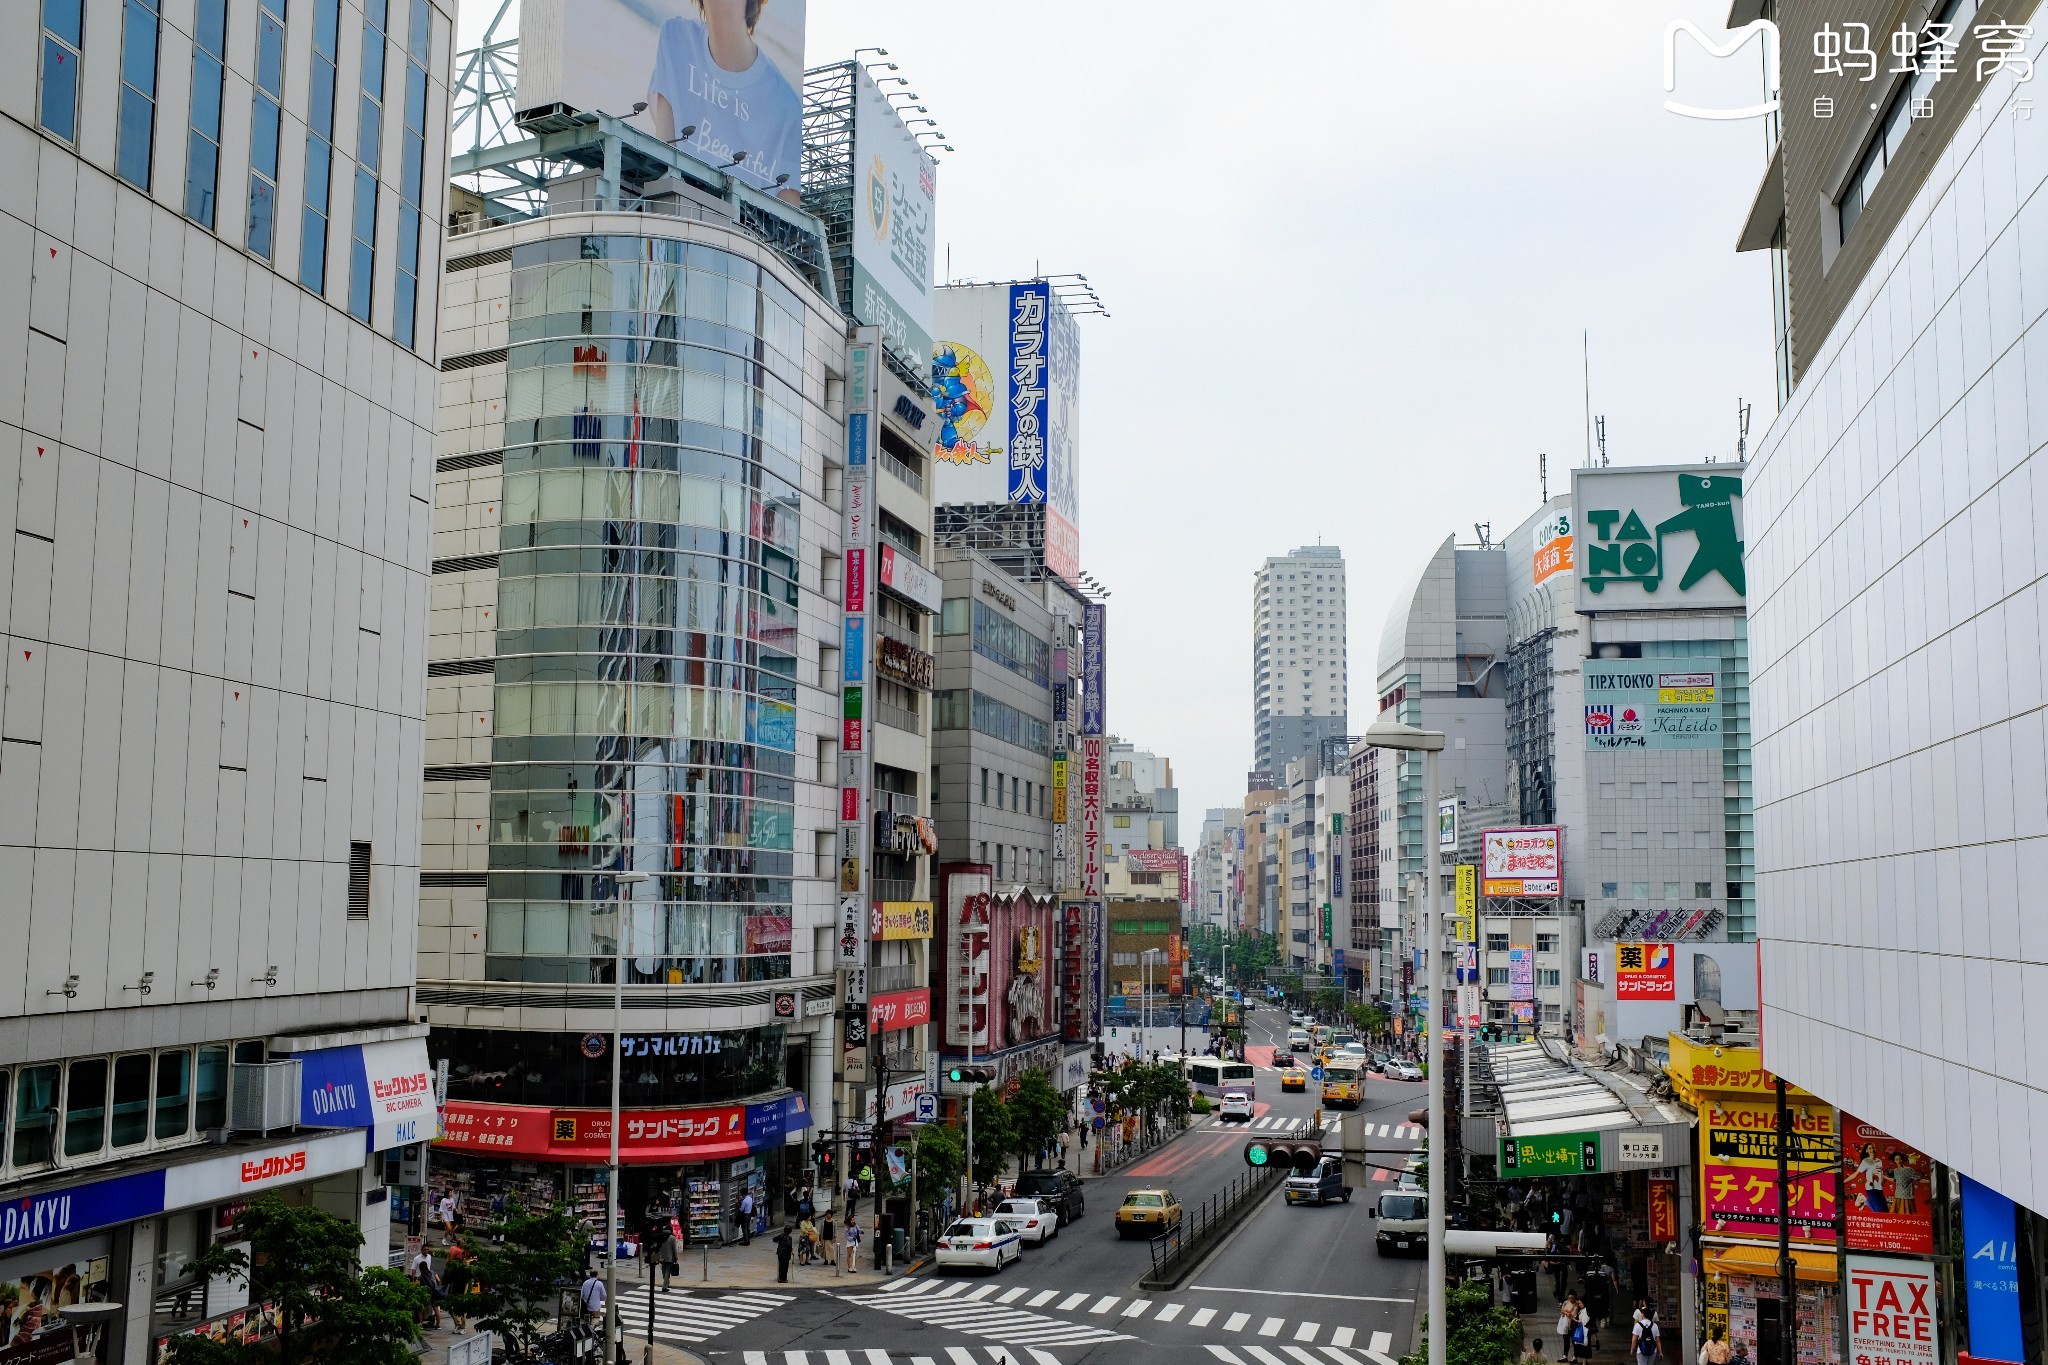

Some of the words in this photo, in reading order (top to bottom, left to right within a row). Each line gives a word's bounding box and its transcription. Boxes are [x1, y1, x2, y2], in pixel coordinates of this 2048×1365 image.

[688, 63, 728, 110] Life
[734, 90, 750, 121] is
[892, 171, 928, 235] シェーン
[892, 208, 926, 282] 英会話
[865, 283, 906, 347] 新宿本校
[1011, 290, 1044, 501] カラオケの鉄人
[1696, 501, 1730, 509] TANO-kun
[1085, 606, 1101, 733] カラオケの鉄人
[1618, 674, 1654, 688] TOKYO
[850, 720, 860, 749] 美容室
[1651, 715, 1717, 733] Kaleido
[1084, 739, 1100, 897] 100名収容大パーティールーム
[1515, 838, 1547, 850] カラオケ
[1507, 853, 1555, 872] まねきねこ
[1465, 869, 1473, 896] Money
[1497, 886, 1521, 894] ワンカラ
[872, 907, 882, 934] 3F
[1625, 908, 1655, 940] バーミヤン
[1656, 907, 1688, 940] ワンカラ
[843, 922, 857, 957] 黒太鼓
[958, 891, 990, 1034] パチンコ
[1620, 946, 1642, 969] 薬
[1618, 980, 1673, 992] サンドラッグ
[872, 1002, 896, 1023] カラオケ
[621, 1035, 721, 1057] サンマルクカフェ
[373, 1073, 428, 1099] ビックカメラ
[1692, 1064, 1763, 1088] 金券ショップ
[313, 1083, 356, 1115] ODAKYU
[386, 1102, 397, 1113] BIC
[398, 1098, 423, 1111] CAMERA
[396, 1121, 416, 1143] HALC
[555, 1118, 576, 1140] 薬
[628, 1116, 720, 1139] サンドラッグ
[1507, 1142, 1514, 1164] 新宿
[1521, 1145, 1578, 1166] 思い出横丁
[1585, 1145, 1595, 1167] 西口
[1623, 1144, 1659, 1152] 東口近道
[241, 1151, 306, 1183] ビックカメラ
[1710, 1174, 1836, 1210] チケット
[0, 1195, 71, 1244] DAKYU
[1651, 1184, 1666, 1236] チケット
[1711, 1204, 1776, 1214] TICKET
[1792, 1210, 1836, 1219] SHOP
[1708, 1282, 1726, 1293] 外国
[1708, 1292, 1727, 1303] 送金
[1852, 1278, 1930, 1316] TAX
[1708, 1312, 1727, 1323] 外貨
[1853, 1311, 1932, 1342] FREE
[1854, 1338, 1896, 1348] EVERYTHING
[1898, 1342, 1911, 1350] TAX
[1914, 1344, 1932, 1352] FREE
